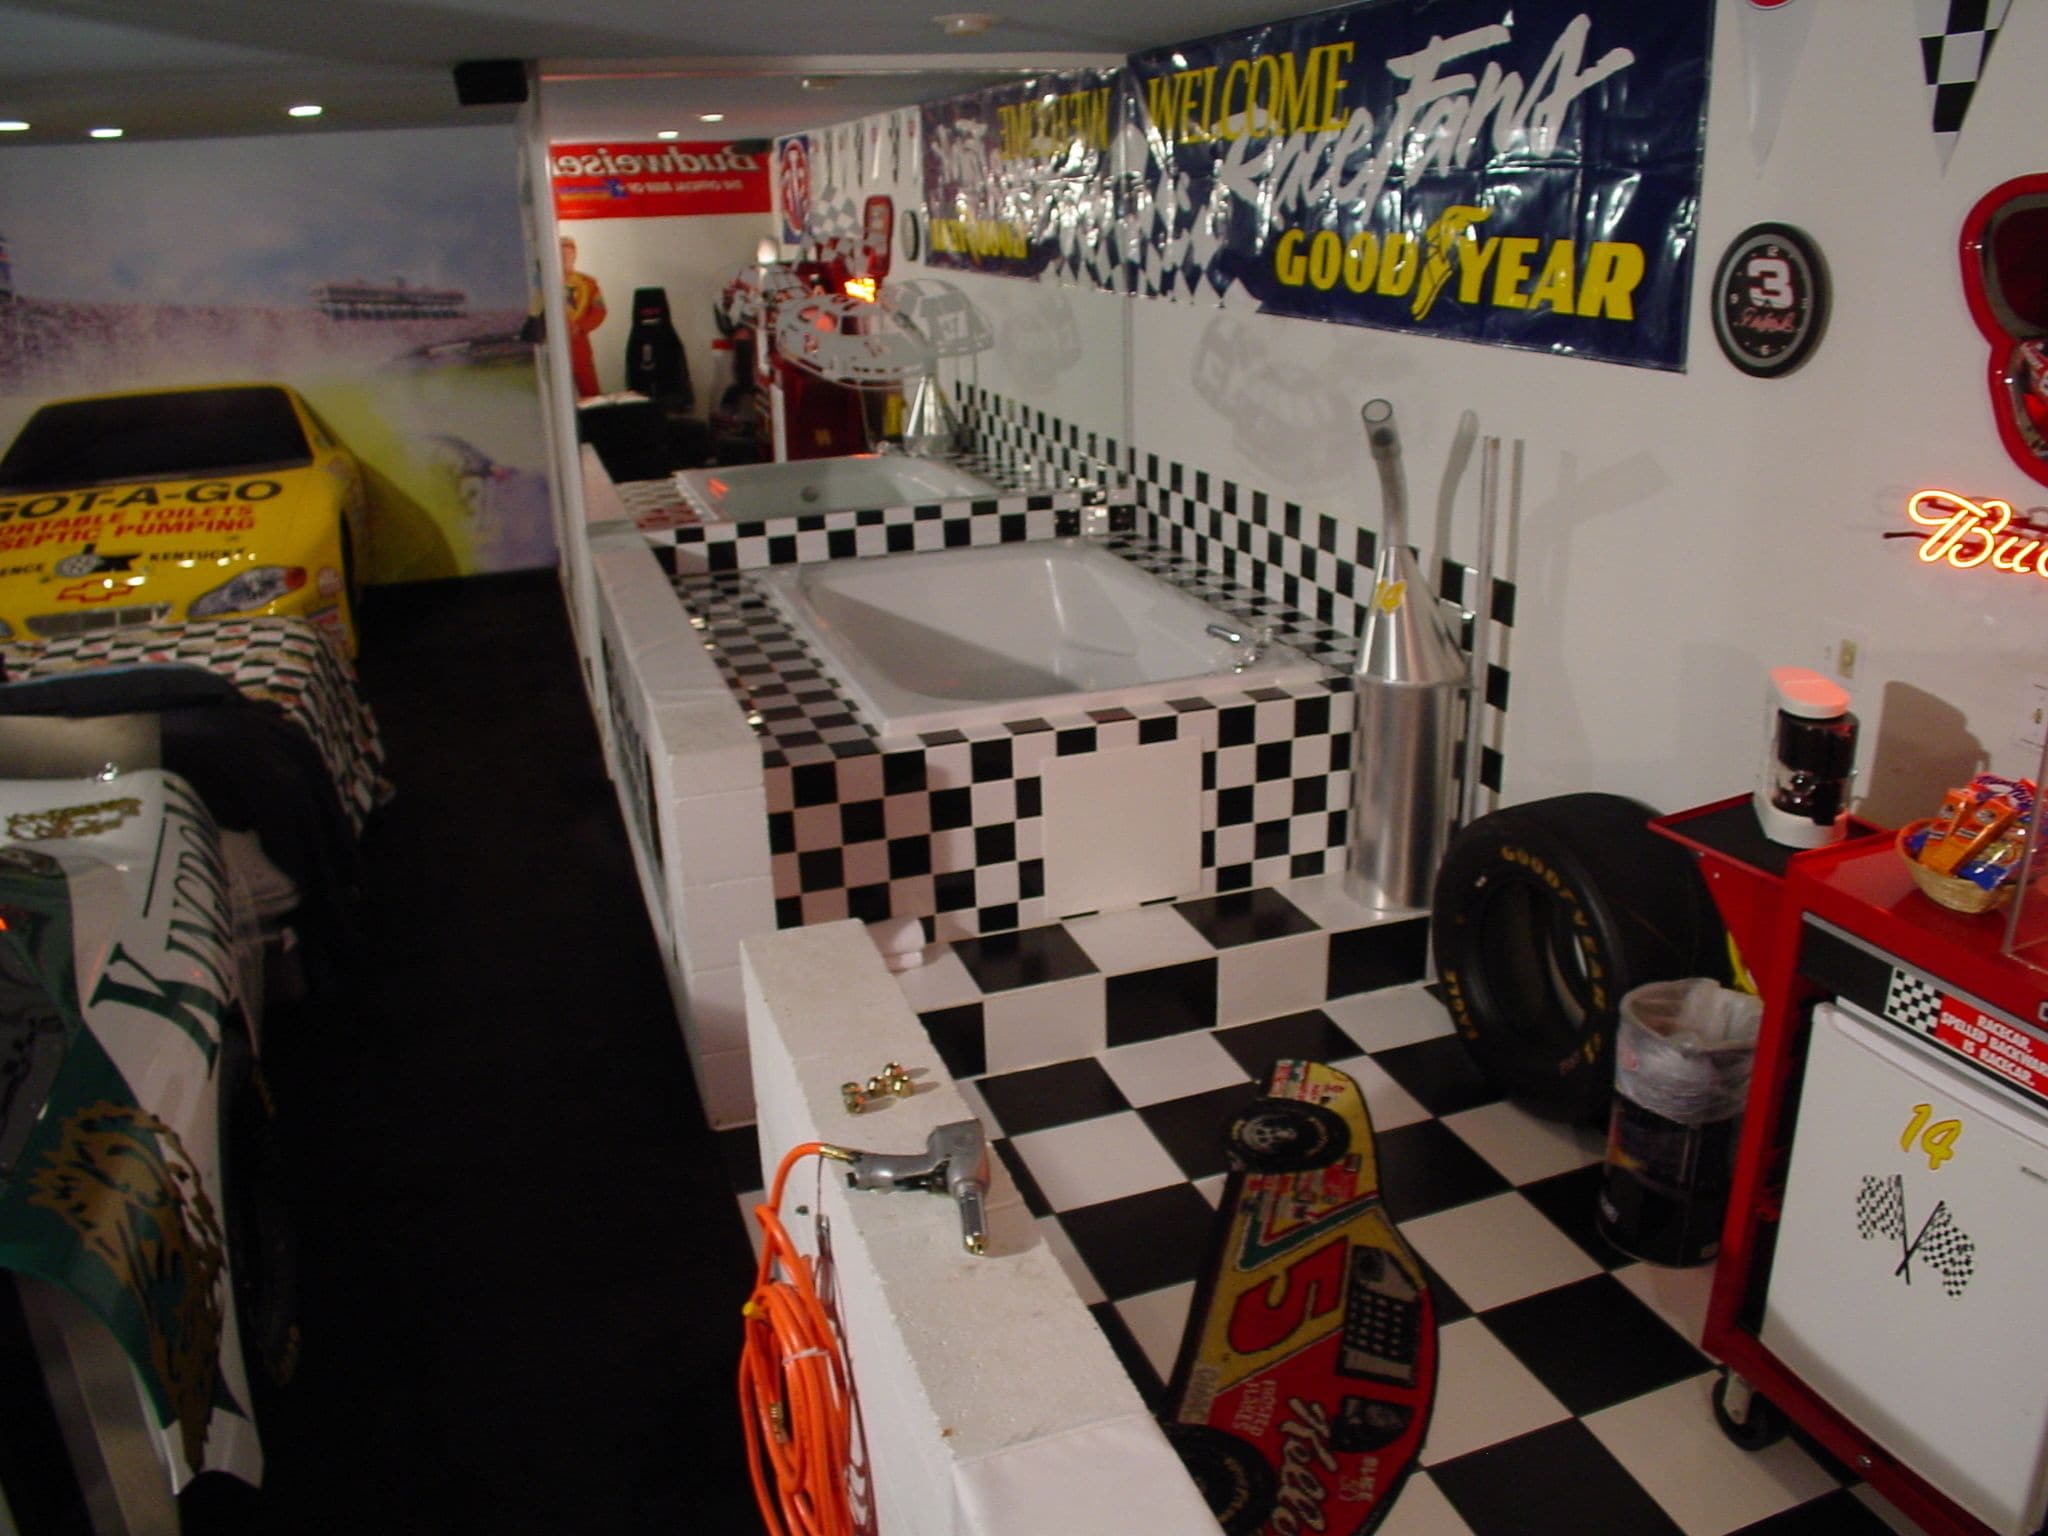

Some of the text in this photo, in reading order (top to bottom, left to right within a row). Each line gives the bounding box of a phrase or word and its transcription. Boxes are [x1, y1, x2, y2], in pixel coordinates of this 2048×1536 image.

[1147, 41, 1356, 145] WELCOME
[1275, 228, 1645, 321] GOODYEAR
[1746, 257, 1795, 310] 3
[114, 518, 255, 538] PUMPING
[142, 504, 254, 522] TOILETS
[1227, 1235, 1350, 1355] 5
